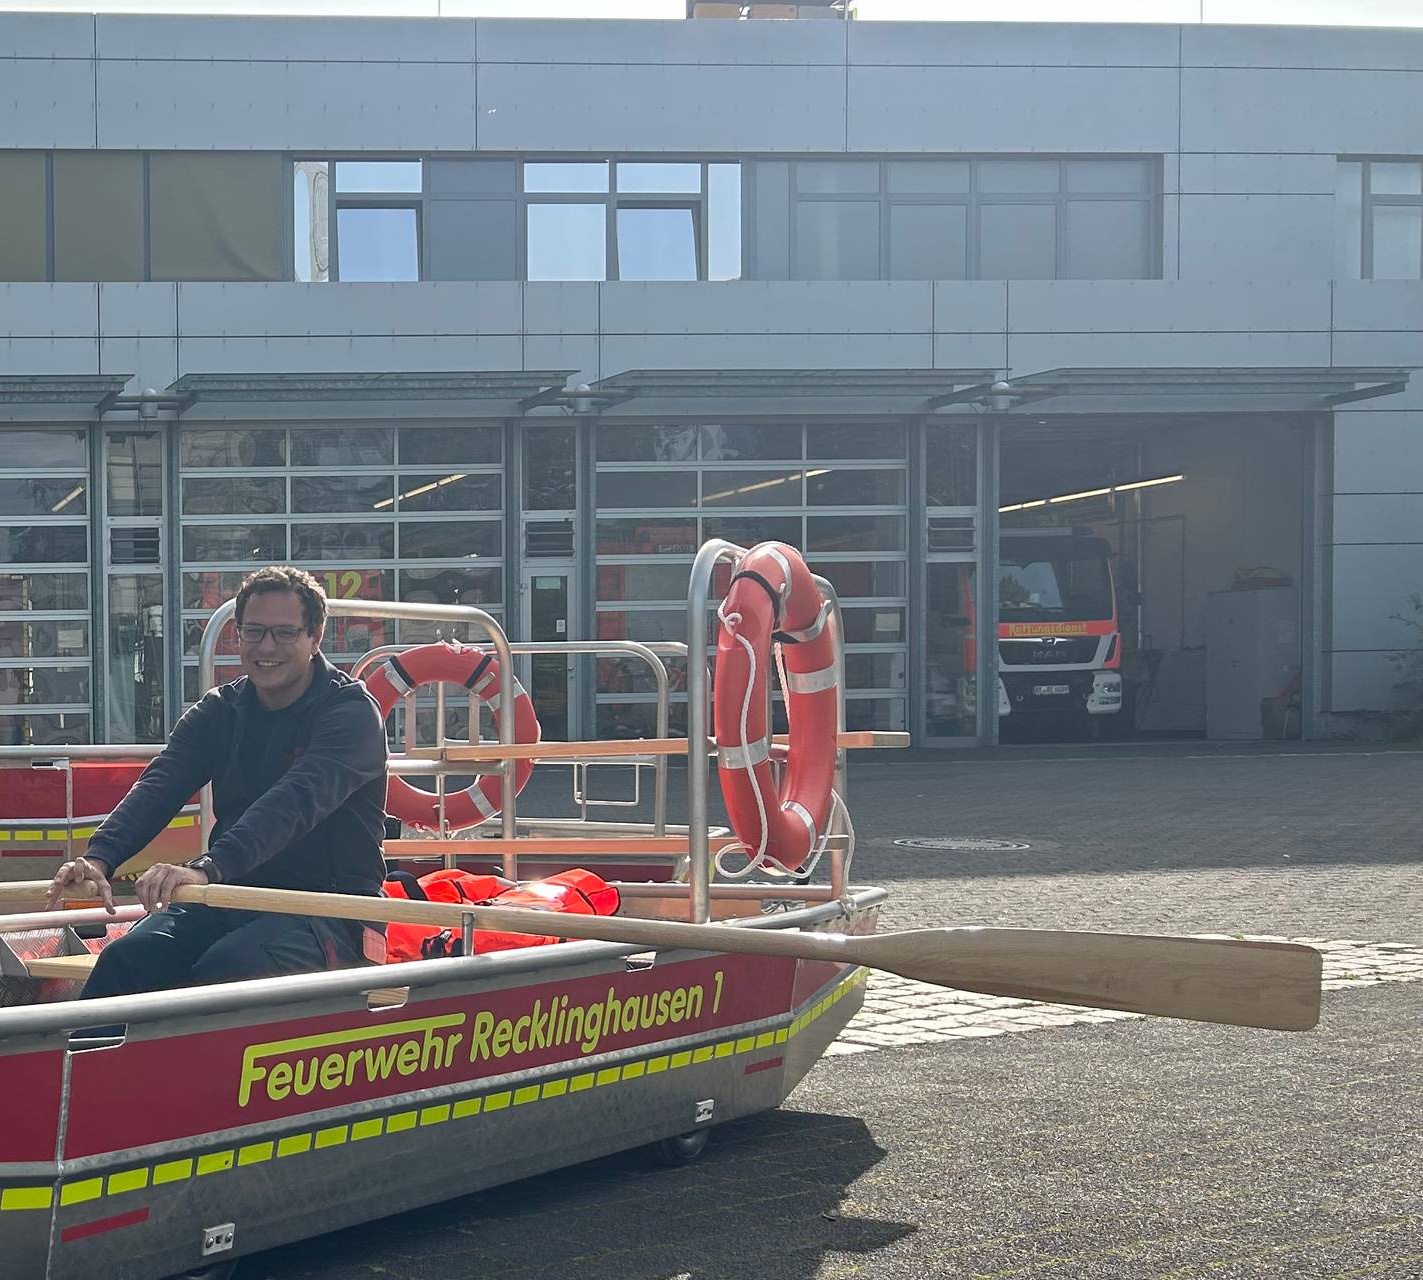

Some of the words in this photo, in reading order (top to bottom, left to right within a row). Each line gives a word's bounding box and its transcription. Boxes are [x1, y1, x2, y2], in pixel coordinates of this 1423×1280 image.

[323, 570, 362, 600] 12
[1009, 623, 1088, 637] Rettungsdienst
[238, 1012, 466, 1108] Feuerwehr
[469, 984, 704, 1062] Recklinghausen
[713, 971, 725, 1014] 1
